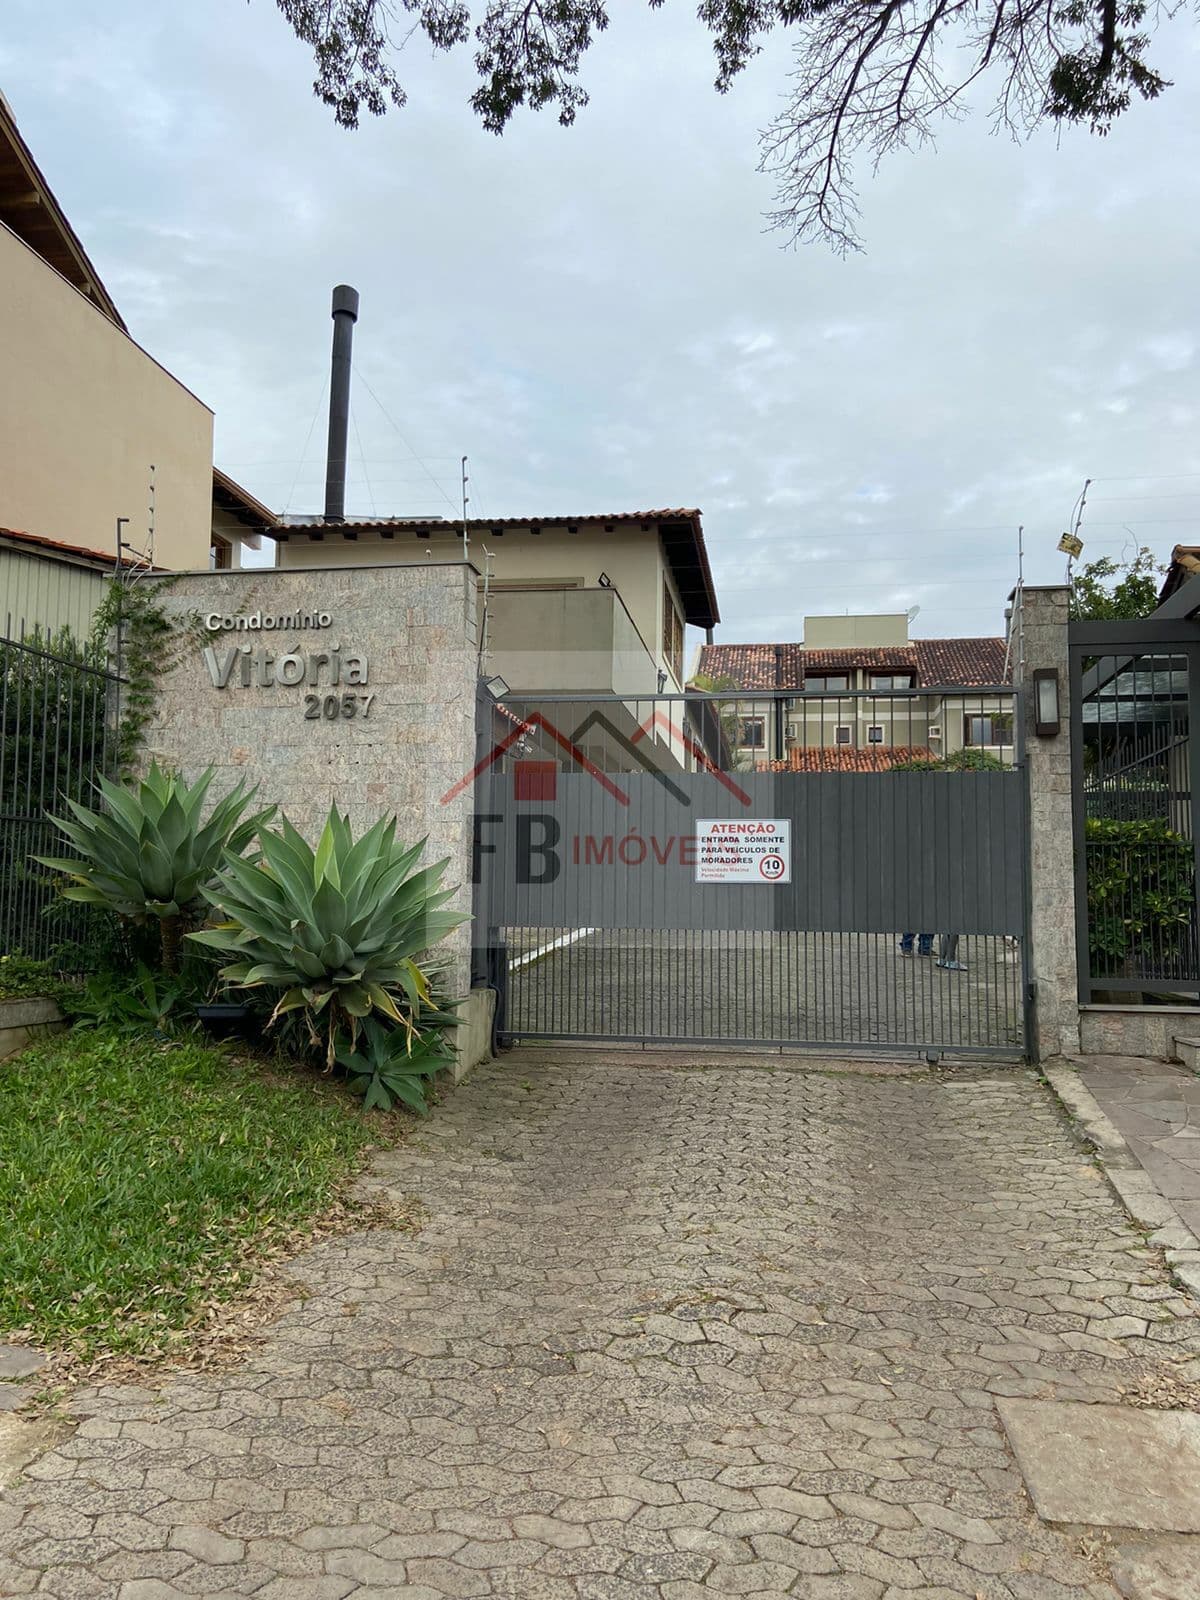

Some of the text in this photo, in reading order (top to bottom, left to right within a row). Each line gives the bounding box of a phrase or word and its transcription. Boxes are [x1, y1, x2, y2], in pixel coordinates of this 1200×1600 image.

[205, 609, 333, 632] Condomínio
[204, 642, 369, 688] Vitória
[304, 693, 376, 720] 2057
[711, 822, 776, 835] ATENÇÃO
[764, 860, 780, 870] 10
